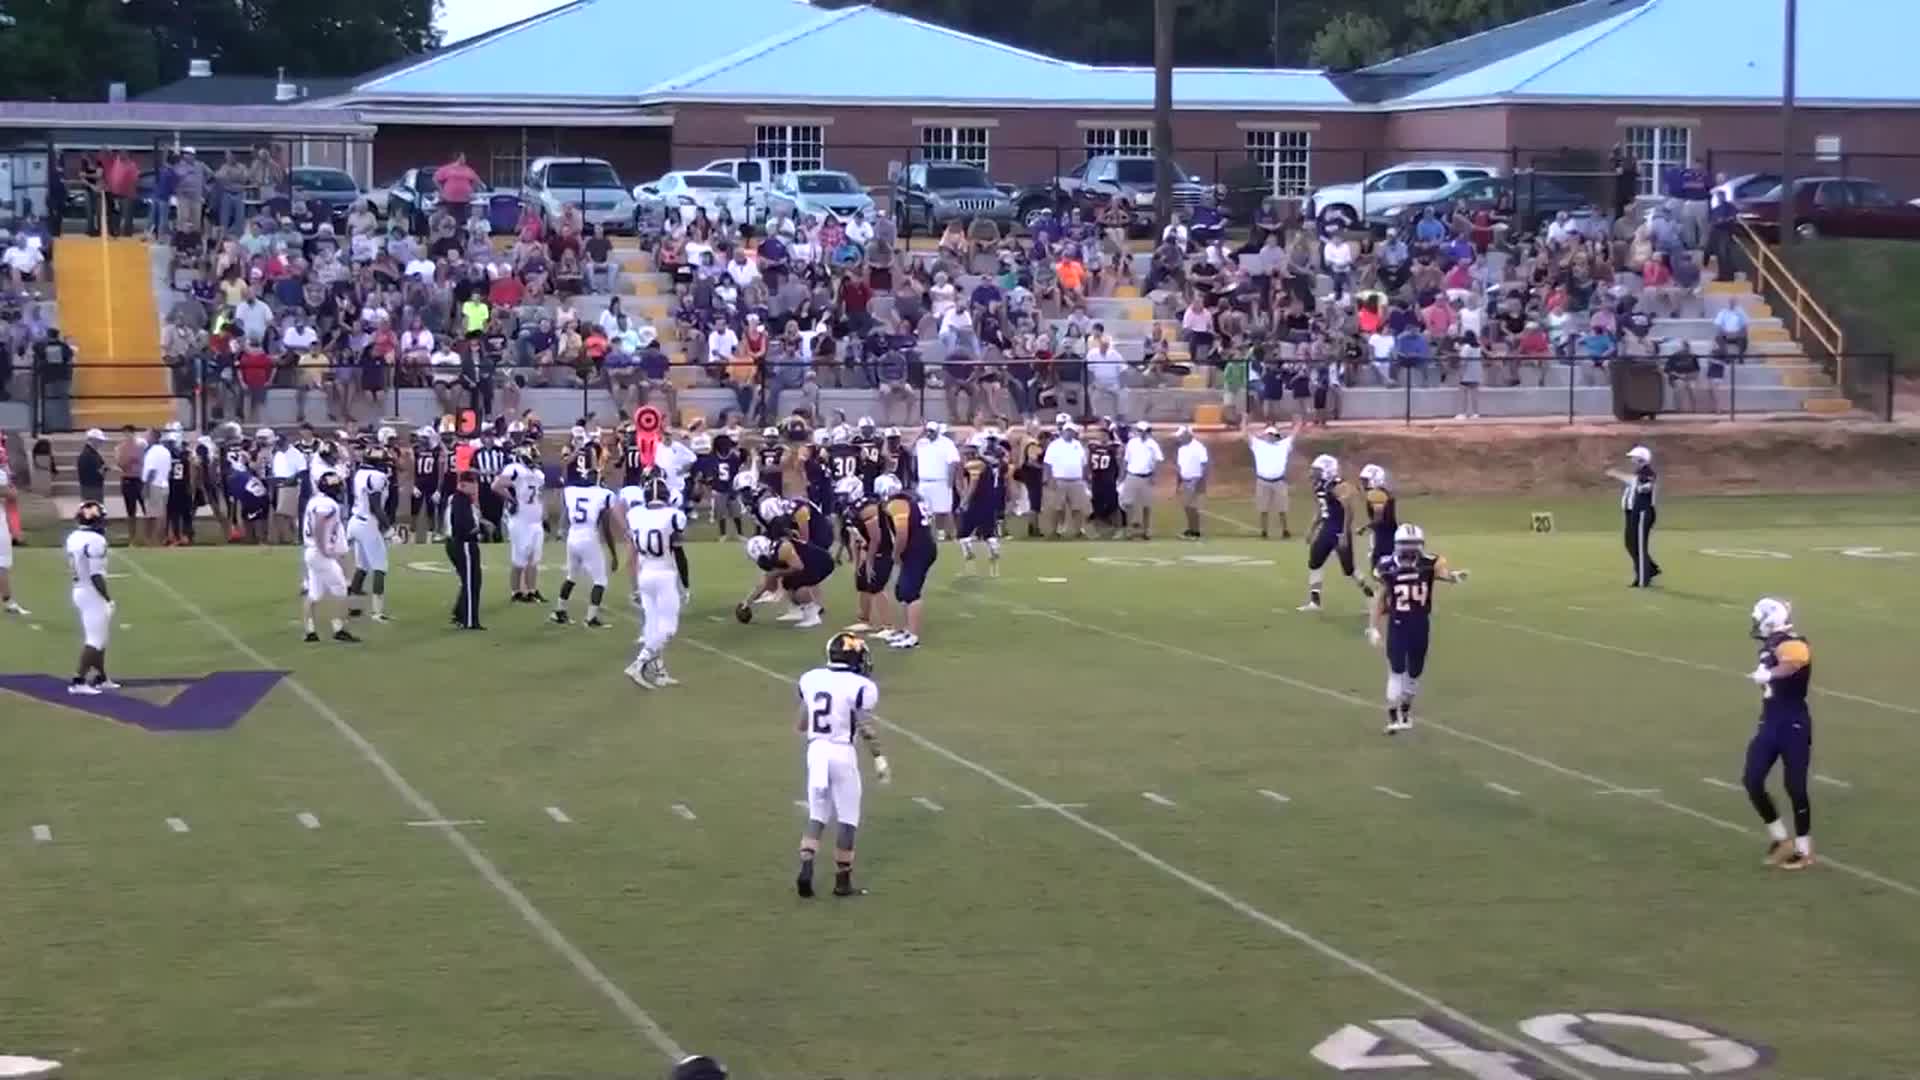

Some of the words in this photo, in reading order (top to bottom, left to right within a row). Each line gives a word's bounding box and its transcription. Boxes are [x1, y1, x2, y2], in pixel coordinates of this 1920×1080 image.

[418, 457, 435, 475] 10
[629, 451, 641, 468] 11
[833, 456, 857, 477] 30
[1091, 454, 1111, 470] 50
[718, 463, 730, 481] 5
[574, 498, 589, 524] 5
[1535, 516, 1552, 533] 20
[633, 530, 664, 557] 10
[1393, 582, 1428, 612] 24
[813, 691, 832, 734] 2
[1309, 1012, 1766, 1080] 40
